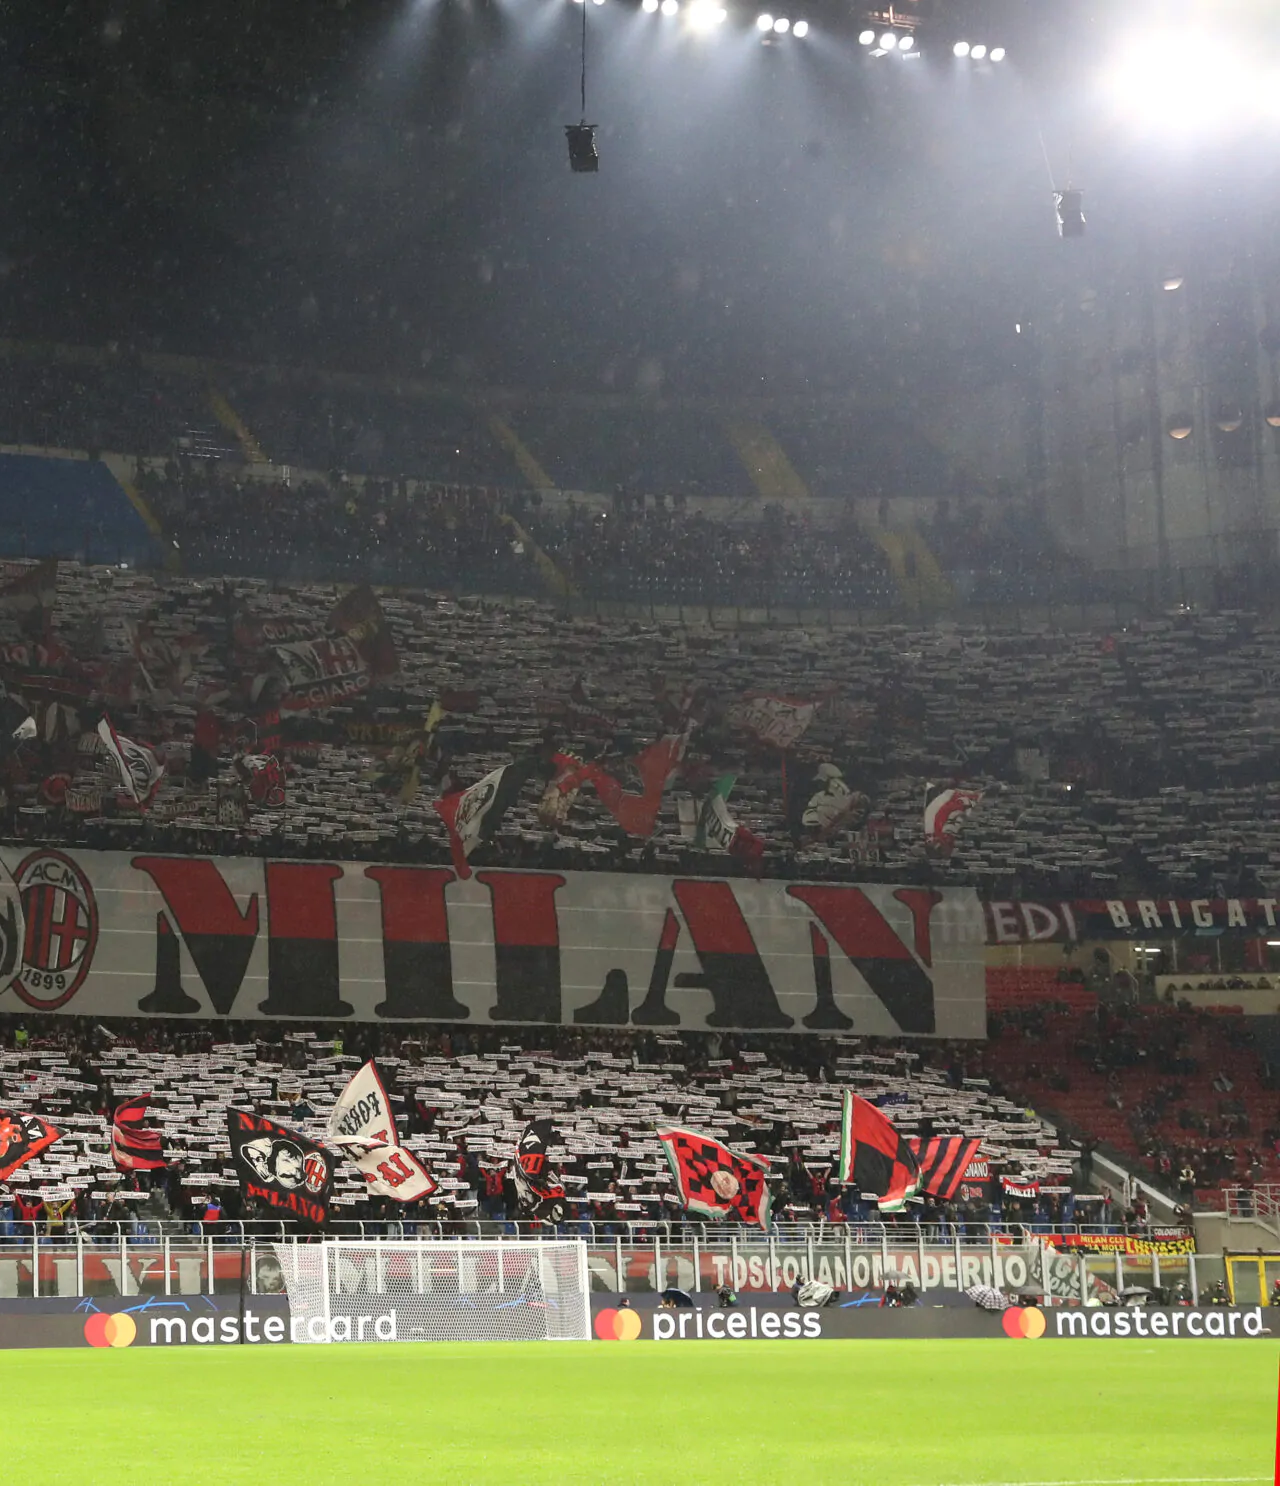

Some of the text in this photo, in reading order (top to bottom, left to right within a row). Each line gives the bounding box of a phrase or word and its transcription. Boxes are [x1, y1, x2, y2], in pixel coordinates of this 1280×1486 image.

[26, 862, 79, 892] ACM
[131, 856, 942, 1034] MILAN
[22, 968, 67, 990] 1899
[246, 1183, 325, 1224] MILANO
[872, 1254, 1026, 1288] MADERNO
[150, 1309, 397, 1345] mastercard
[653, 1306, 822, 1341] priceless
[1056, 1306, 1263, 1338] mastercard
